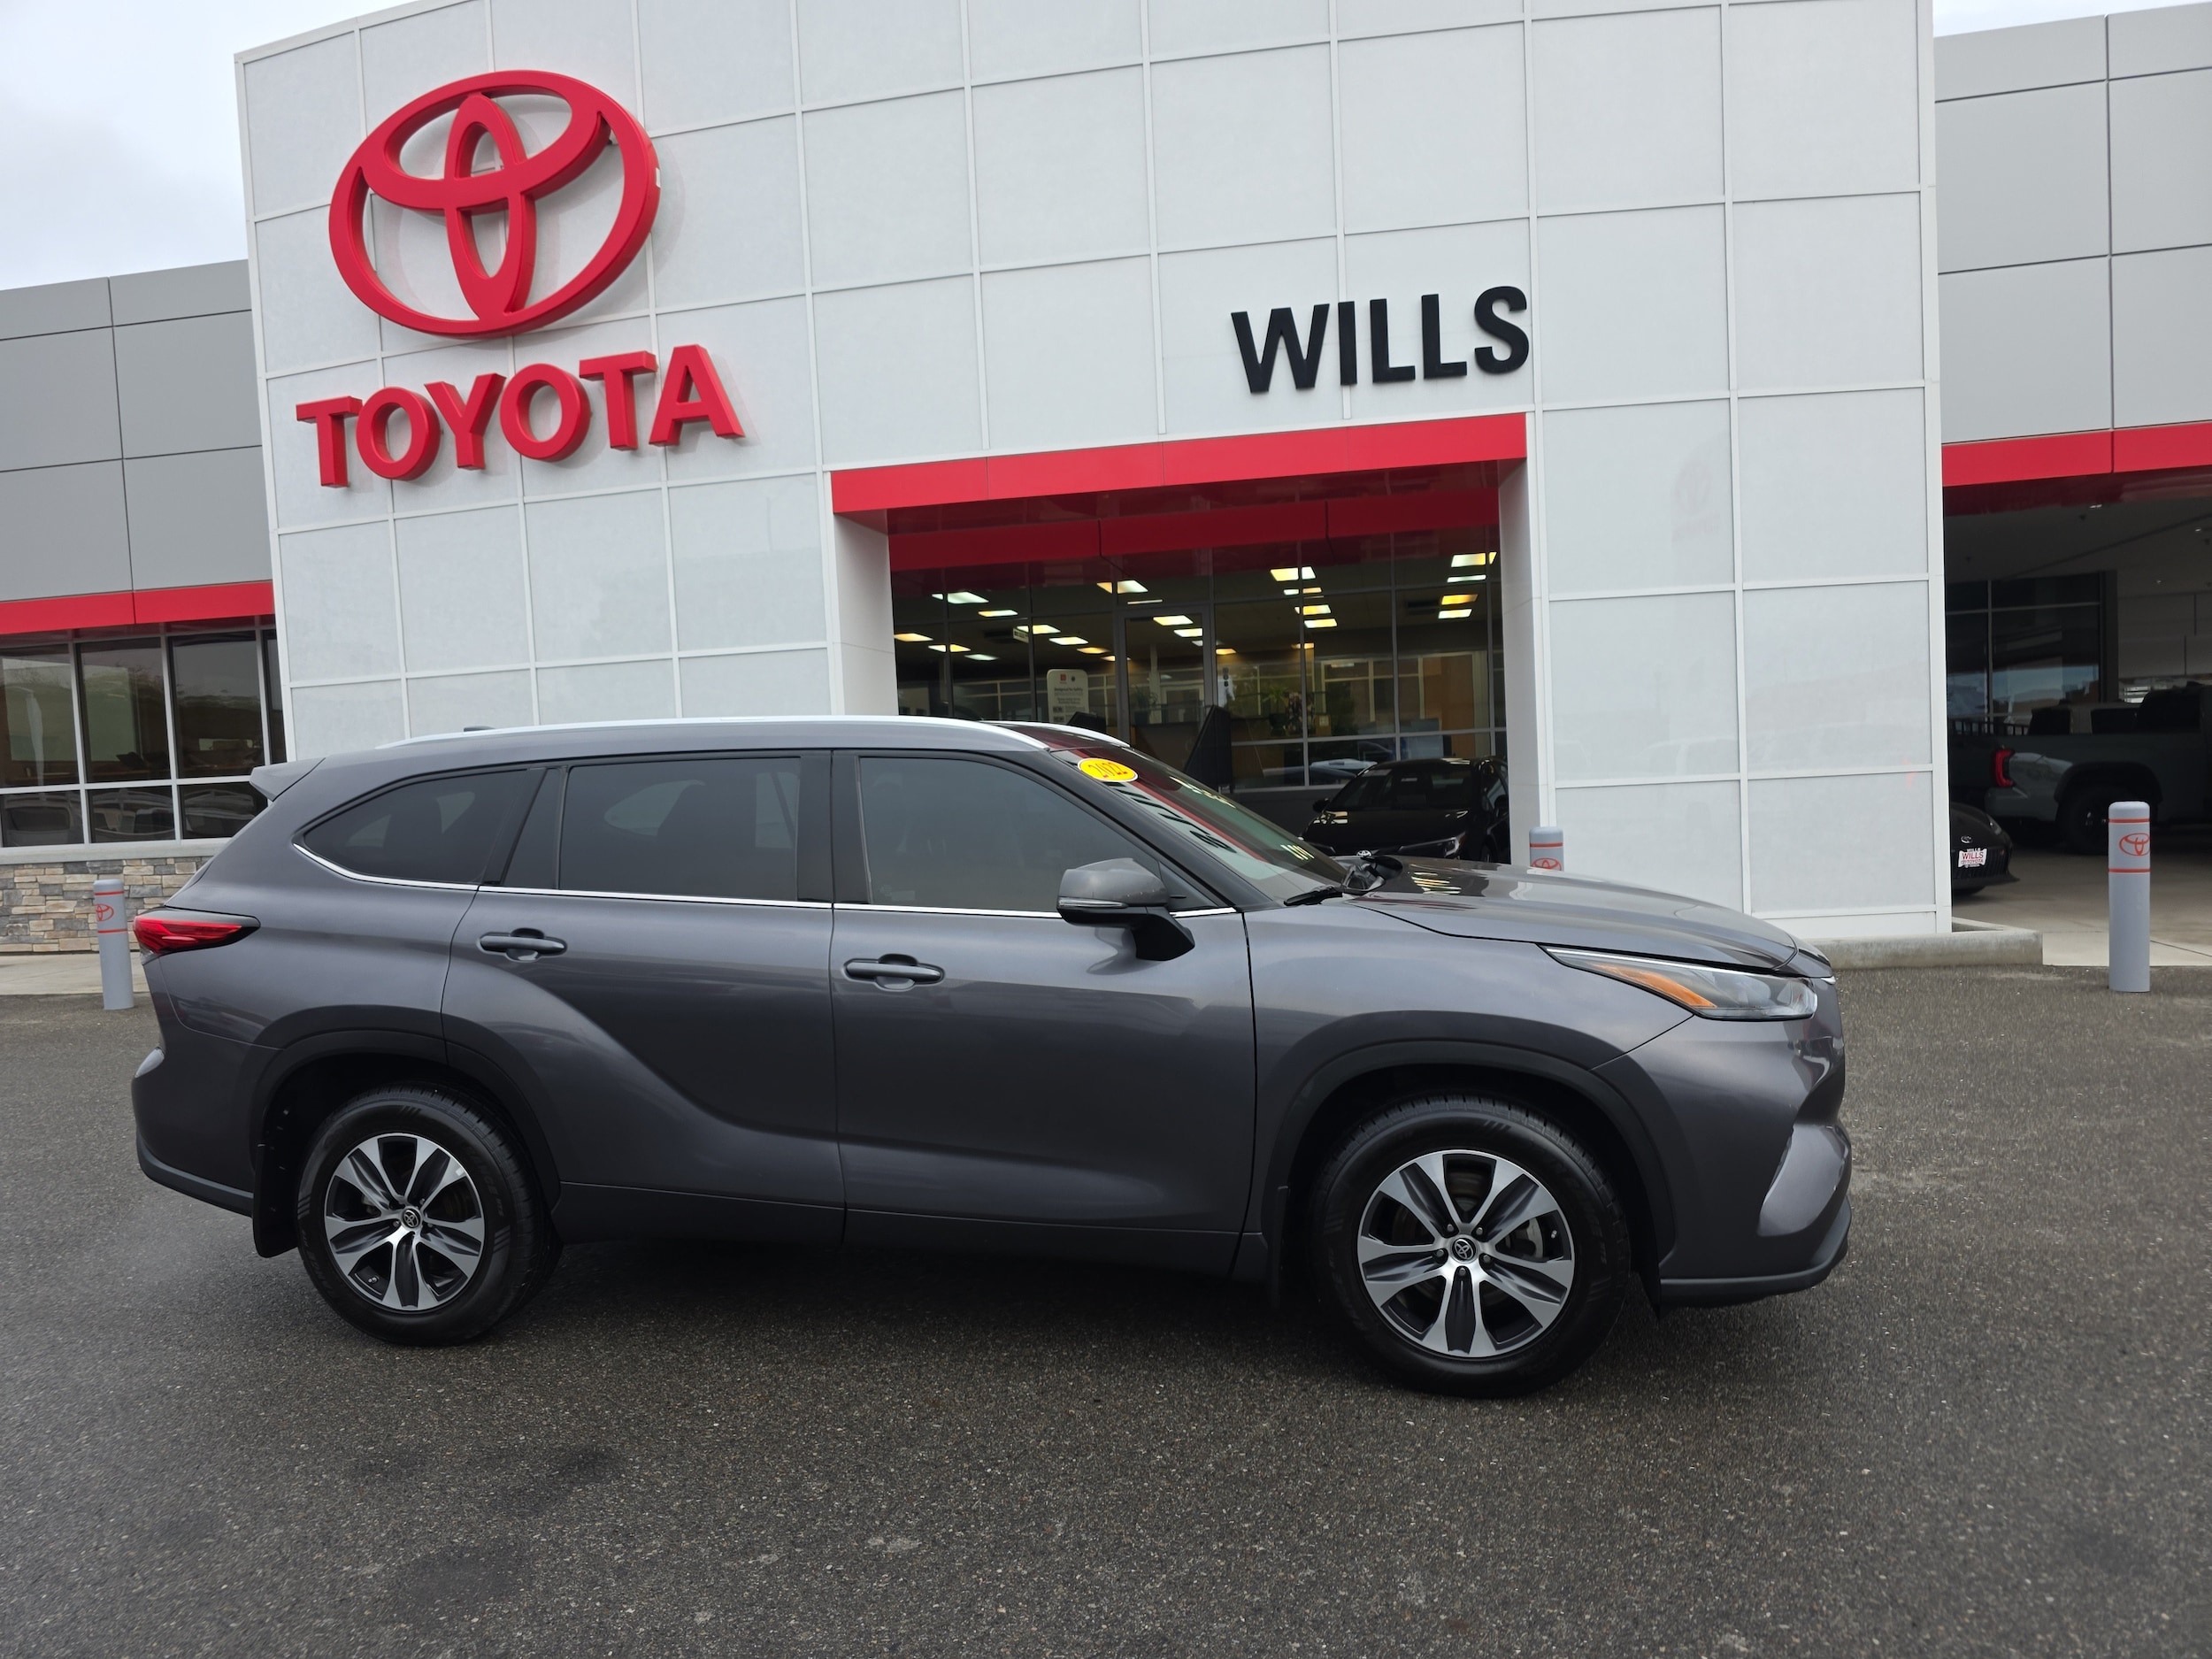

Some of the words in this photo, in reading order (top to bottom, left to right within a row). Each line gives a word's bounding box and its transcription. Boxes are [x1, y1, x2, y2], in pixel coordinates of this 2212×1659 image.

[1231, 286, 1529, 394] WILLS
[296, 344, 745, 488] TOYOTA
[1088, 762, 1128, 778] 2022
